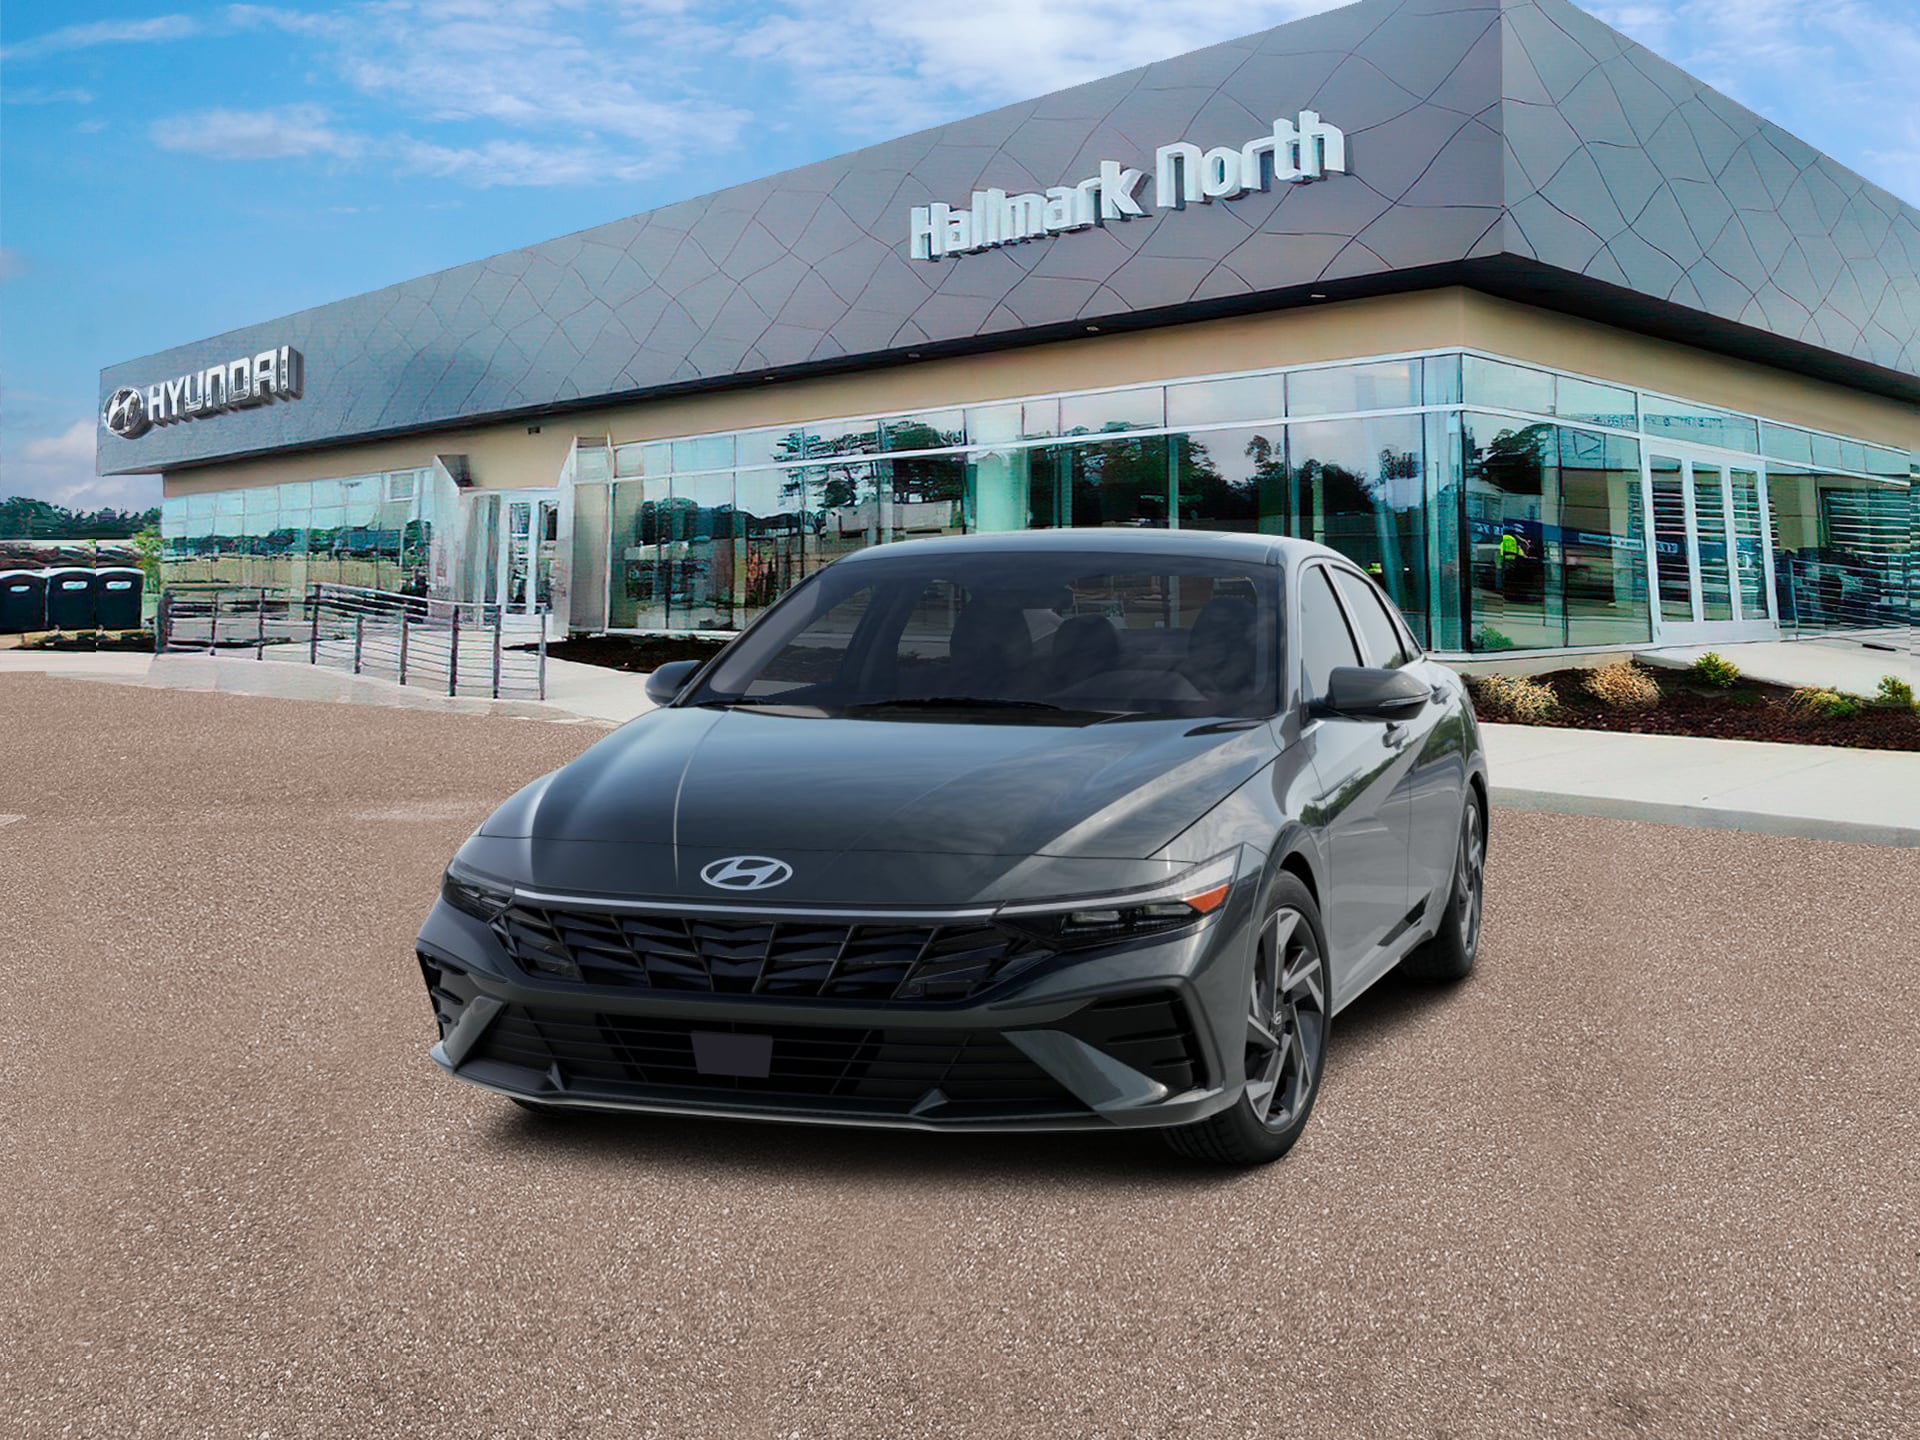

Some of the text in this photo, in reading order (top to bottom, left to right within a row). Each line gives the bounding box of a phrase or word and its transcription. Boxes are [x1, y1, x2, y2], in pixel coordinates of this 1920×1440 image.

[910, 109, 1347, 261] Hallmark North
[148, 345, 298, 424] HYUNDAI
